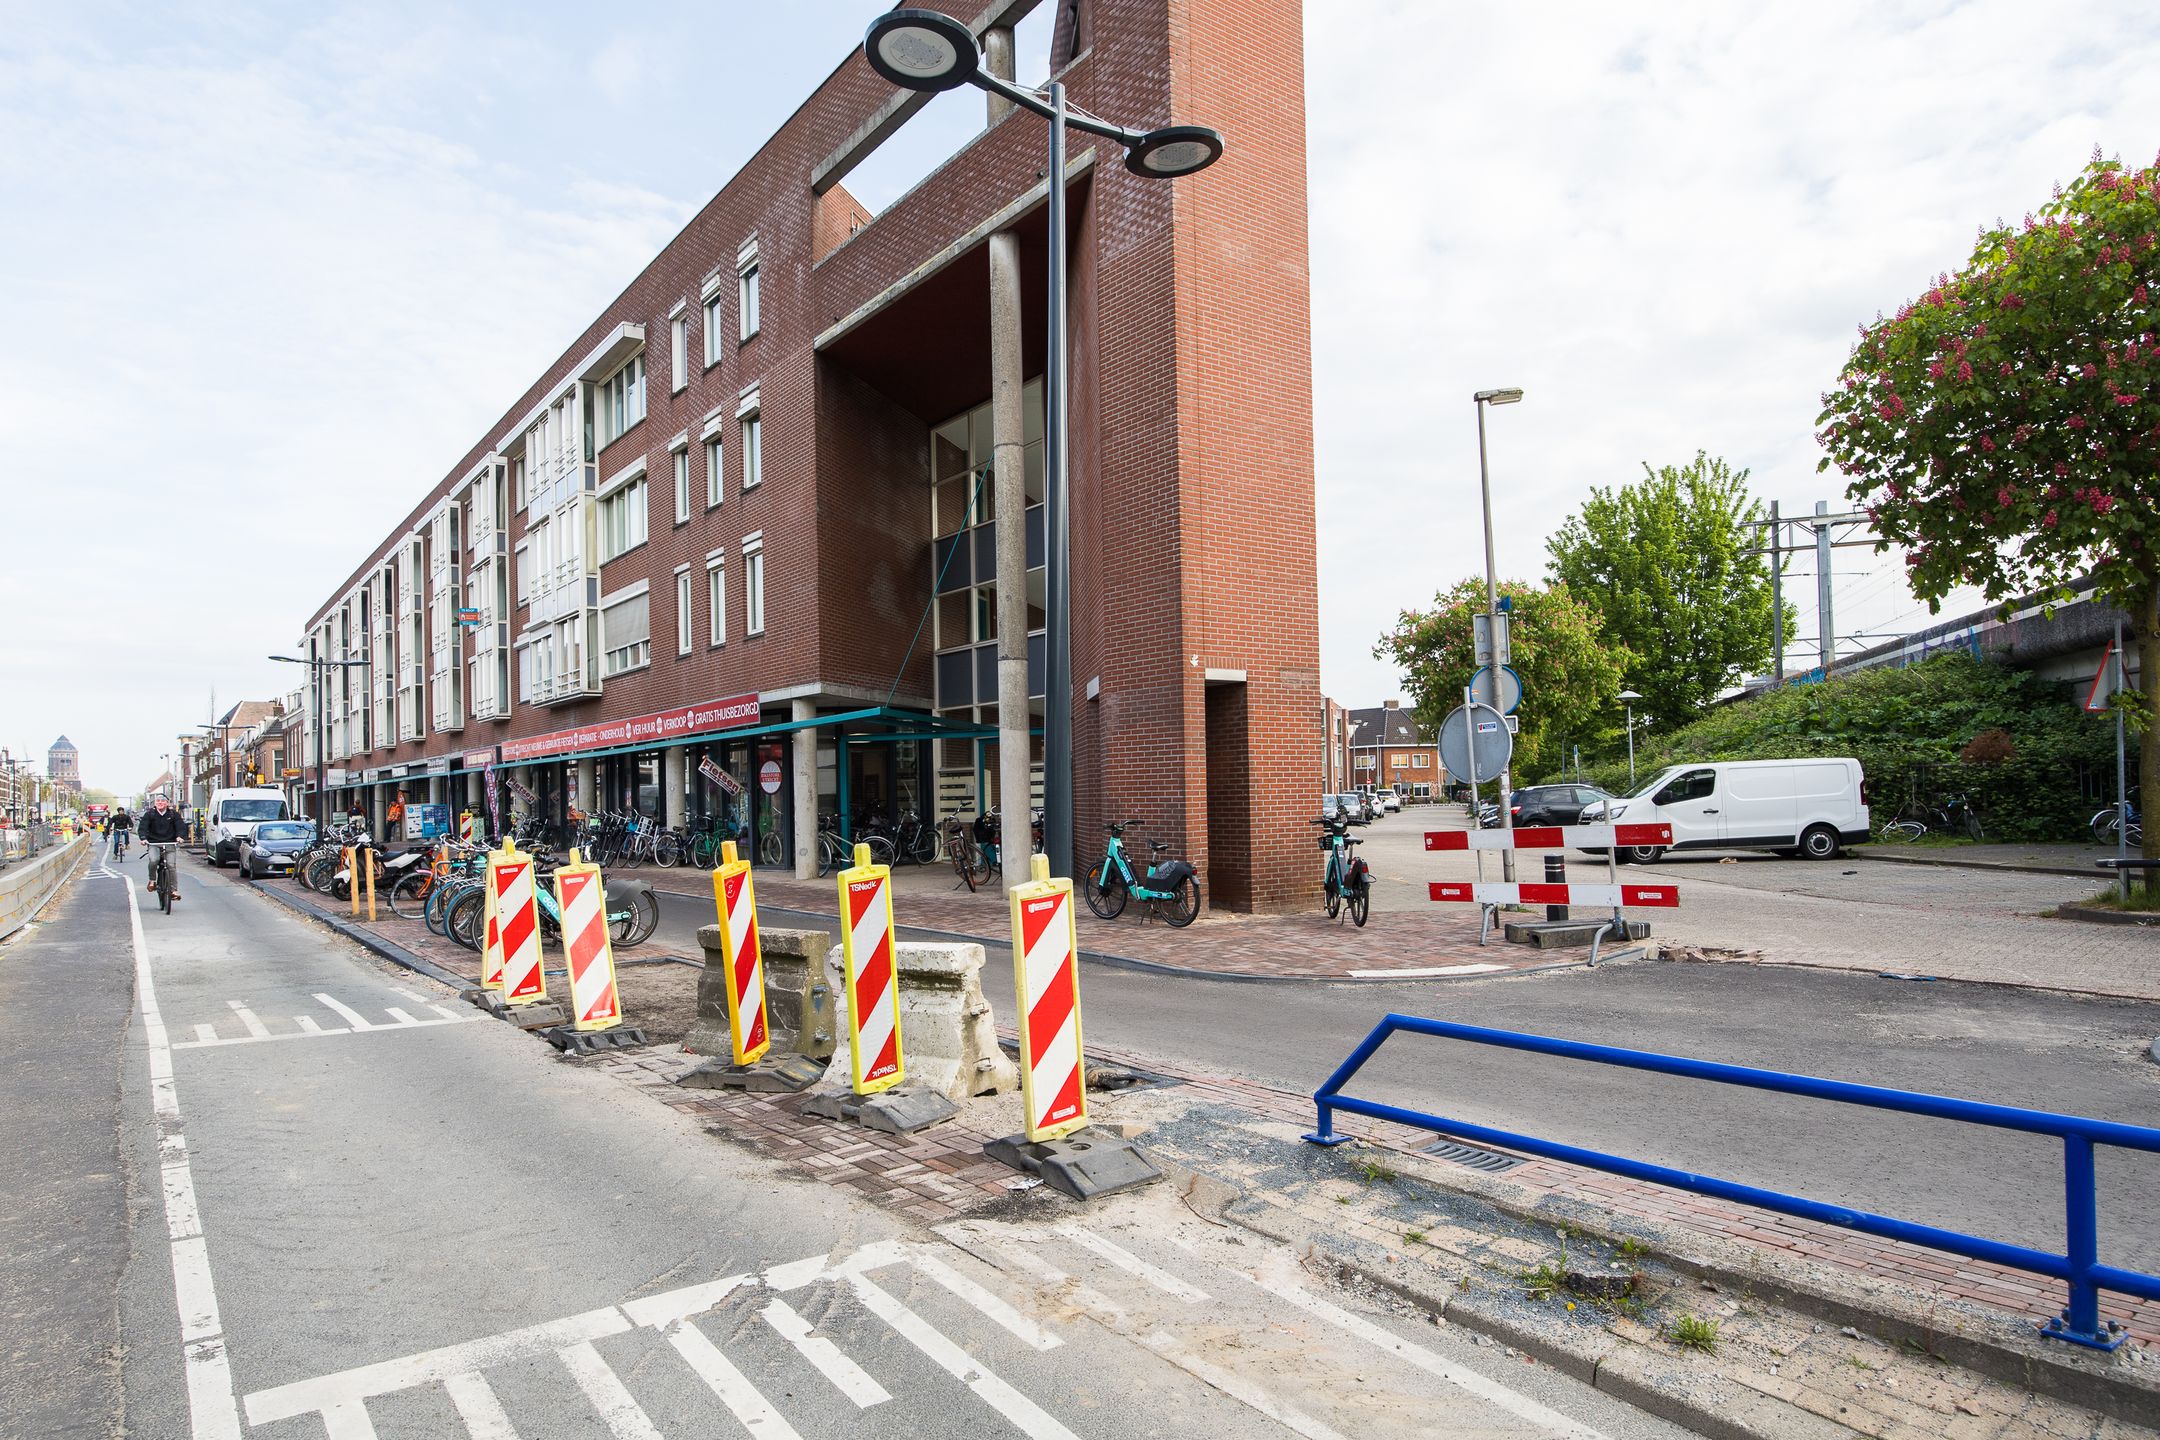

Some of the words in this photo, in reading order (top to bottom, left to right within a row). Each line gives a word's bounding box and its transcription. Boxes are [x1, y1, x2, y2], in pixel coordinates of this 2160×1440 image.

[600, 727, 625, 740] ONDERHOUD
[663, 716, 687, 730] VERKOOP
[695, 710, 714, 725] GRATIS
[714, 701, 759, 721] THUISBEZORGD
[702, 759, 740, 792] Fietsen
